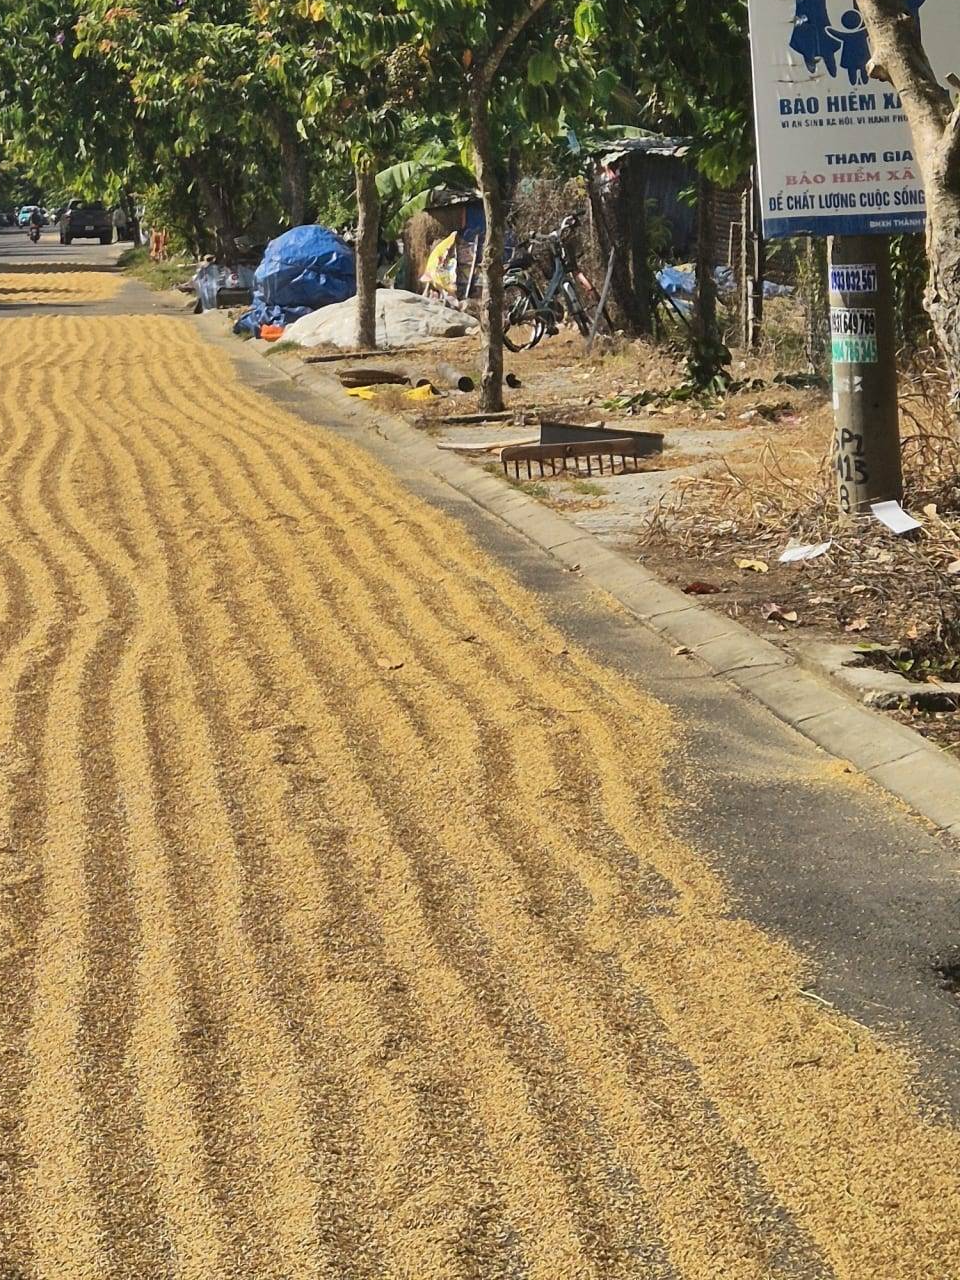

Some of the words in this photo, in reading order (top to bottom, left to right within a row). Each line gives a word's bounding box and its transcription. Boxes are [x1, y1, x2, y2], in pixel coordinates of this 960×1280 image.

[825, 152, 876, 165] THAM
[882, 150, 913, 162] GIA
[785, 170, 826, 186] BẢO
[832, 166, 881, 183] HIỂM
[887, 167, 915, 181] XÃ
[769, 190, 783, 212] ĐỂ
[786, 188, 815, 210] CHẤT
[818, 191, 856, 212] LƯỢNG
[859, 189, 890, 211] CUỘC
[894, 185, 925, 206] SỐNG
